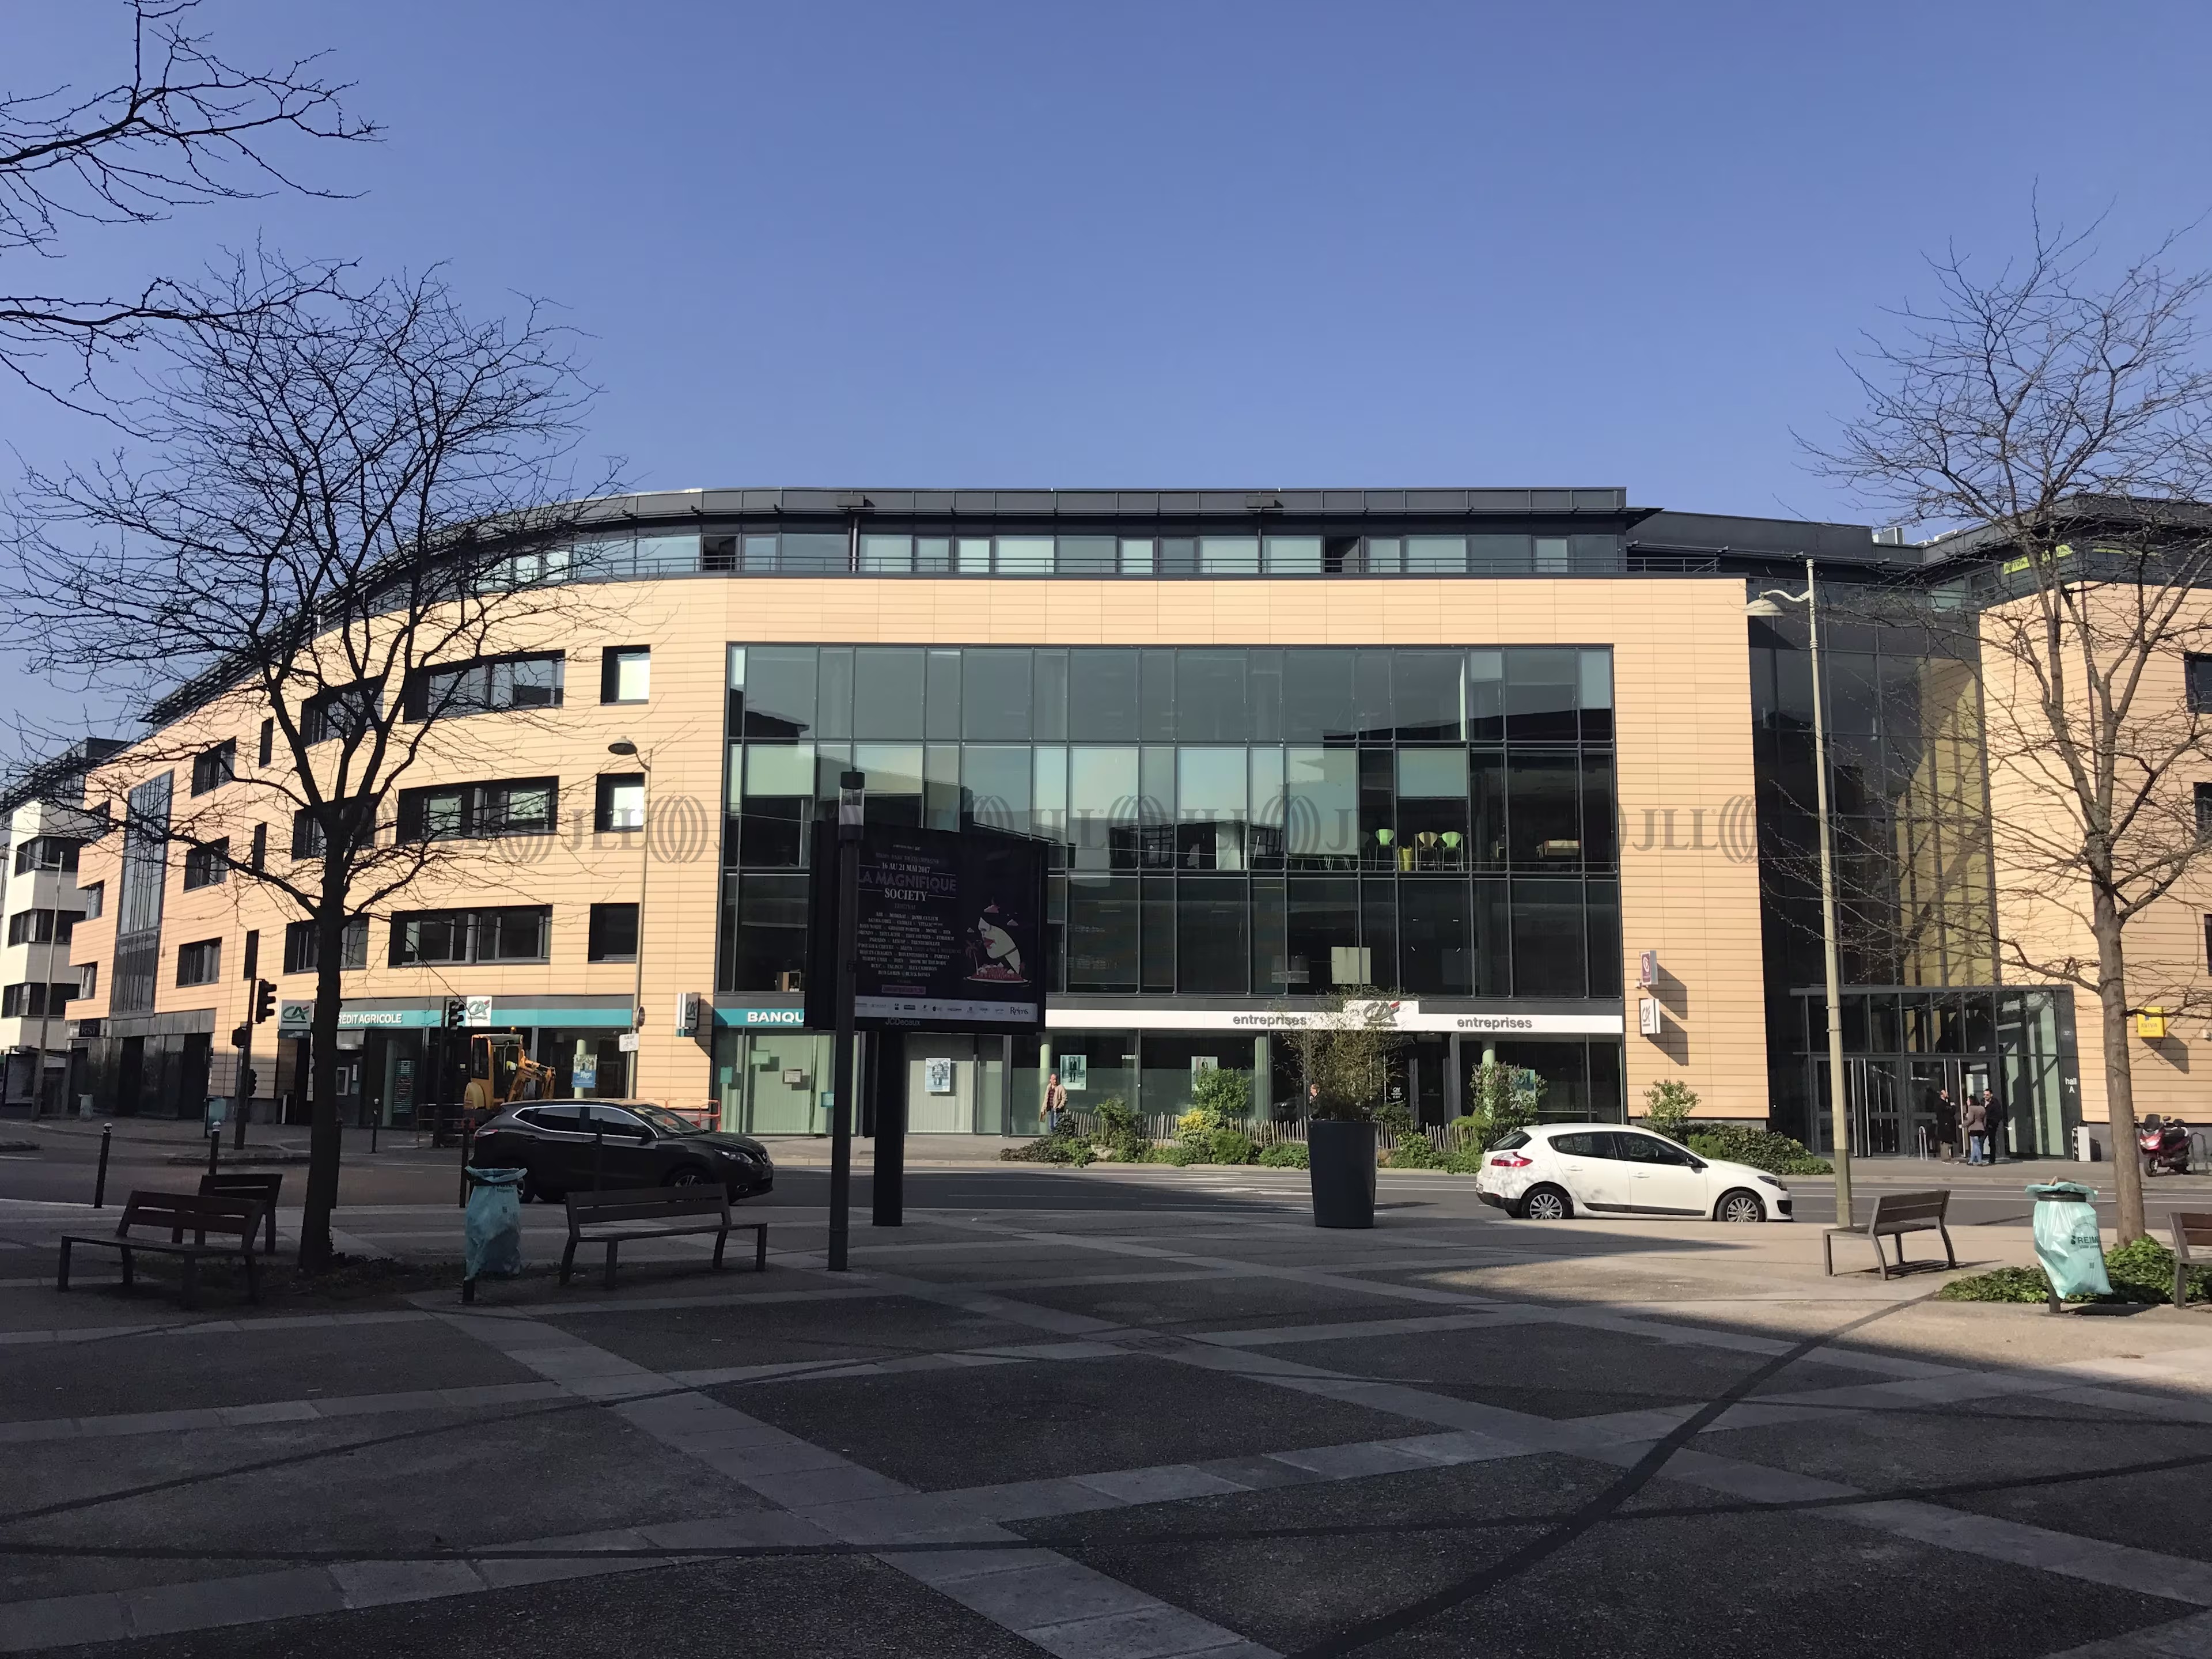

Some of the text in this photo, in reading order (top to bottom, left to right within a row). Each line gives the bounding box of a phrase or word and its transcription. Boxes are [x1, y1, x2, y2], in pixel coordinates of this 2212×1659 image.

[882, 862, 888, 870] 16
[906, 864, 918, 873] MAI
[918, 865, 931, 874] 2017
[875, 871, 957, 893] MAGNIFIQUE
[884, 888, 928, 902] SOCIETY
[748, 1012, 804, 1022] BANQU
[1010, 1006, 1029, 1016] Reims
[338, 1013, 403, 1025] RÉDIT AGRICOLE
[885, 1017, 921, 1027] JCDecaux
[1233, 1014, 1307, 1027] entreprises
[1457, 1017, 1532, 1030] entreprises
[2065, 1077, 2077, 1085] hall
[2077, 1236, 2099, 1244] REIM
